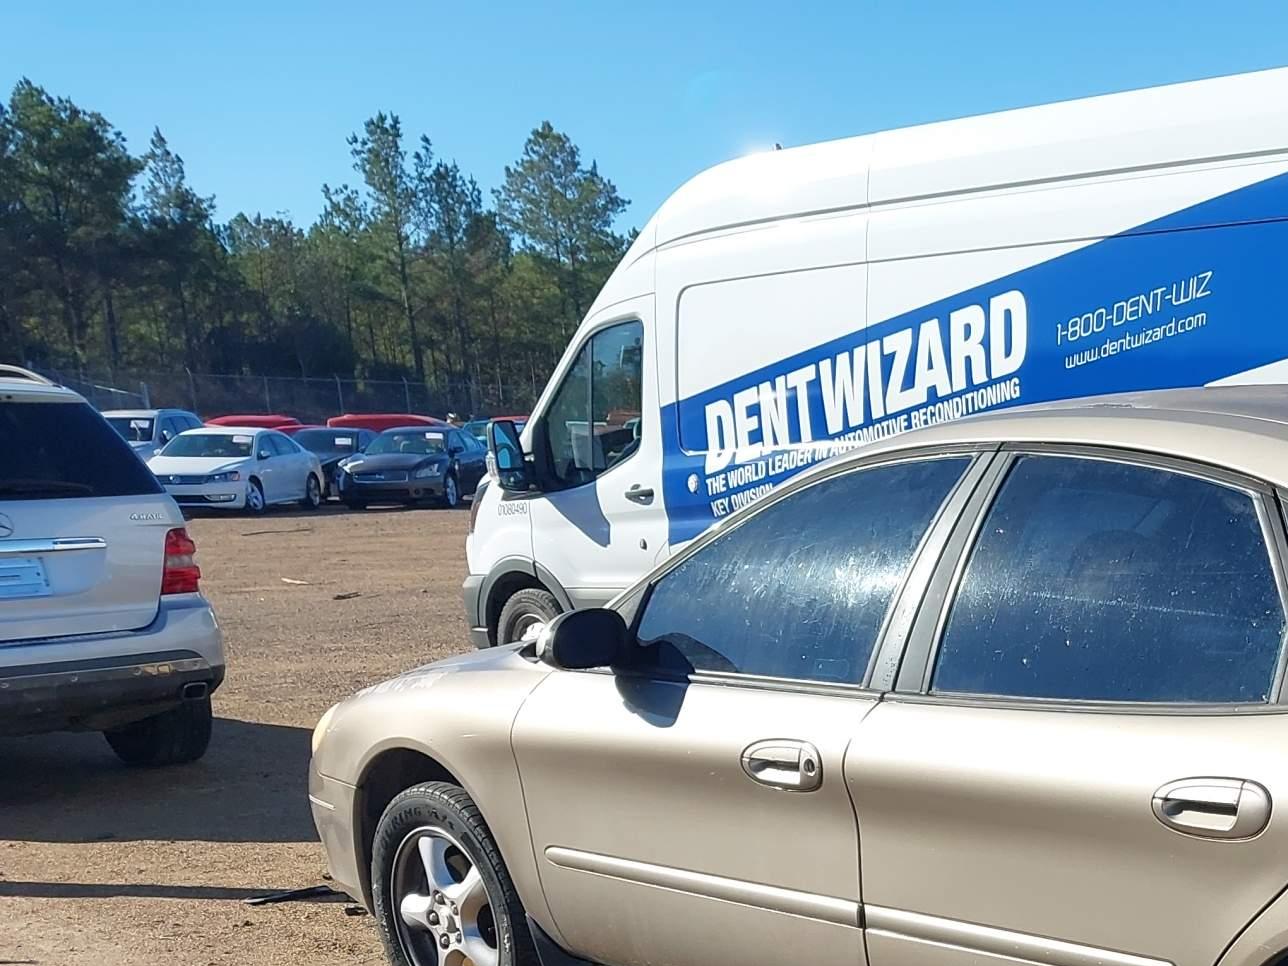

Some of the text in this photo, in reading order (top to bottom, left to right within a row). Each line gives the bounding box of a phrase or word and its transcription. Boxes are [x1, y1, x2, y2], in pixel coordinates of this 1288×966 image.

[1056, 270, 1213, 346] 1-800-DENT-WIZ
[1065, 312, 1207, 369] www.dentwizard.com
[705, 473, 727, 497] THE
[726, 461, 767, 490] WORLD
[767, 449, 813, 477] LEADER
[831, 414, 908, 457] AUTOMOTIVE
[910, 377, 1021, 429] RECONDITIONING
[710, 497, 730, 518] KEY
